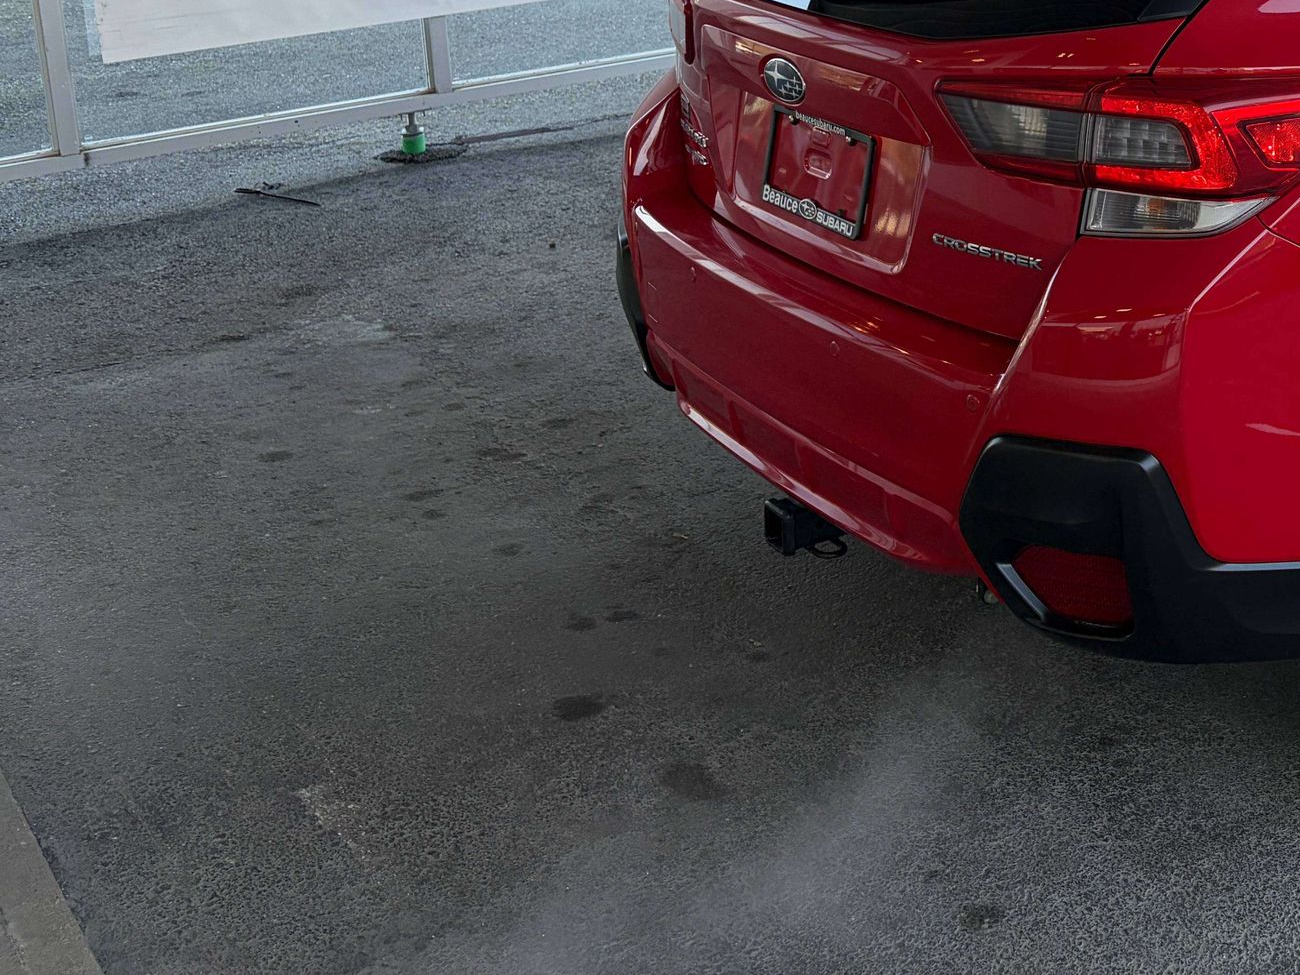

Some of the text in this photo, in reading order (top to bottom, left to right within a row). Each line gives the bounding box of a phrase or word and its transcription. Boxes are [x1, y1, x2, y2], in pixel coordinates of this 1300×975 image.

[762, 184, 853, 237] Beauce SUBARU
[932, 233, 1043, 271] CROSSTREK
